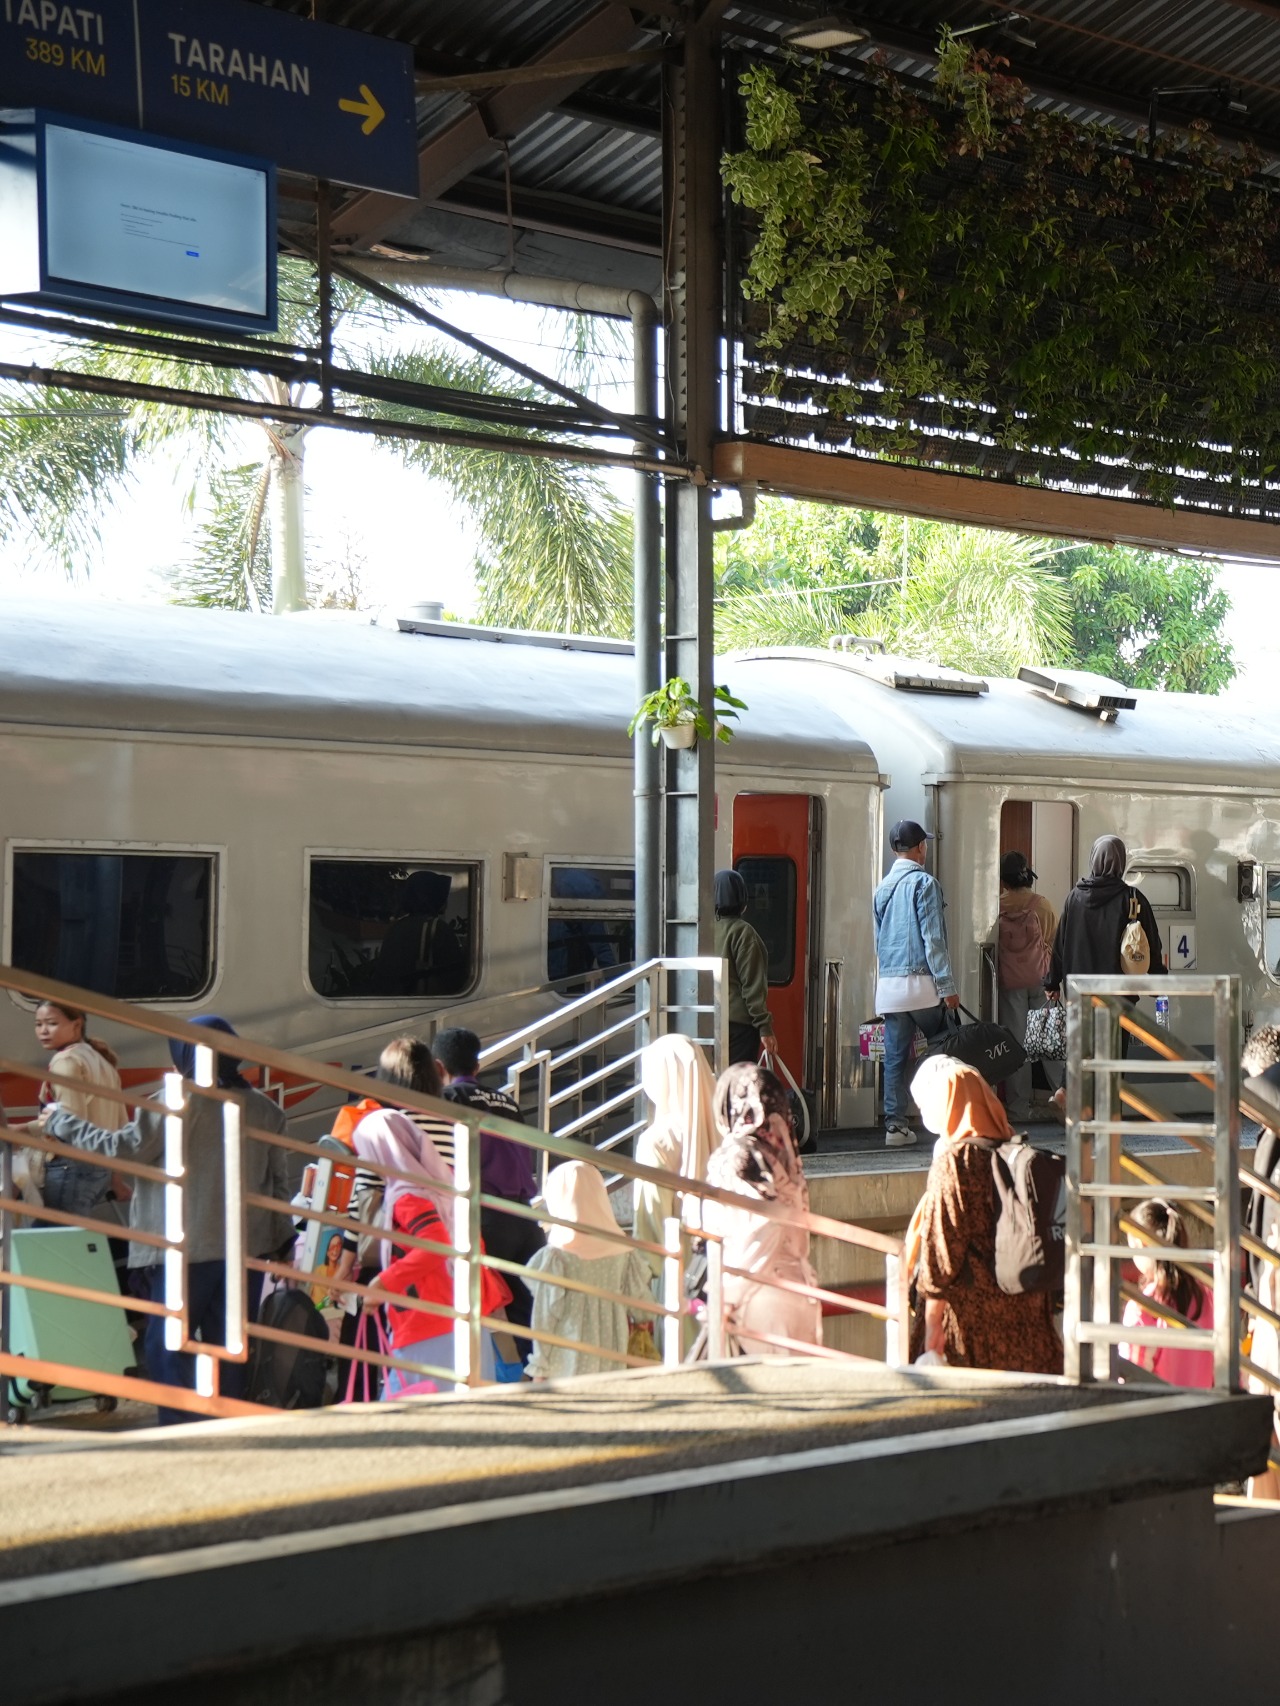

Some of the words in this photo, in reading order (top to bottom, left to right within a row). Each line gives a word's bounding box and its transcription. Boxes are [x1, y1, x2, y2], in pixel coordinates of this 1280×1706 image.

[25, 37, 65, 67] 389
[70, 47, 106, 77] KM
[168, 32, 310, 96] TARAHAN
[171, 74, 191, 97] 15
[196, 77, 229, 106] KM
[1177, 935, 1189, 958] 4
